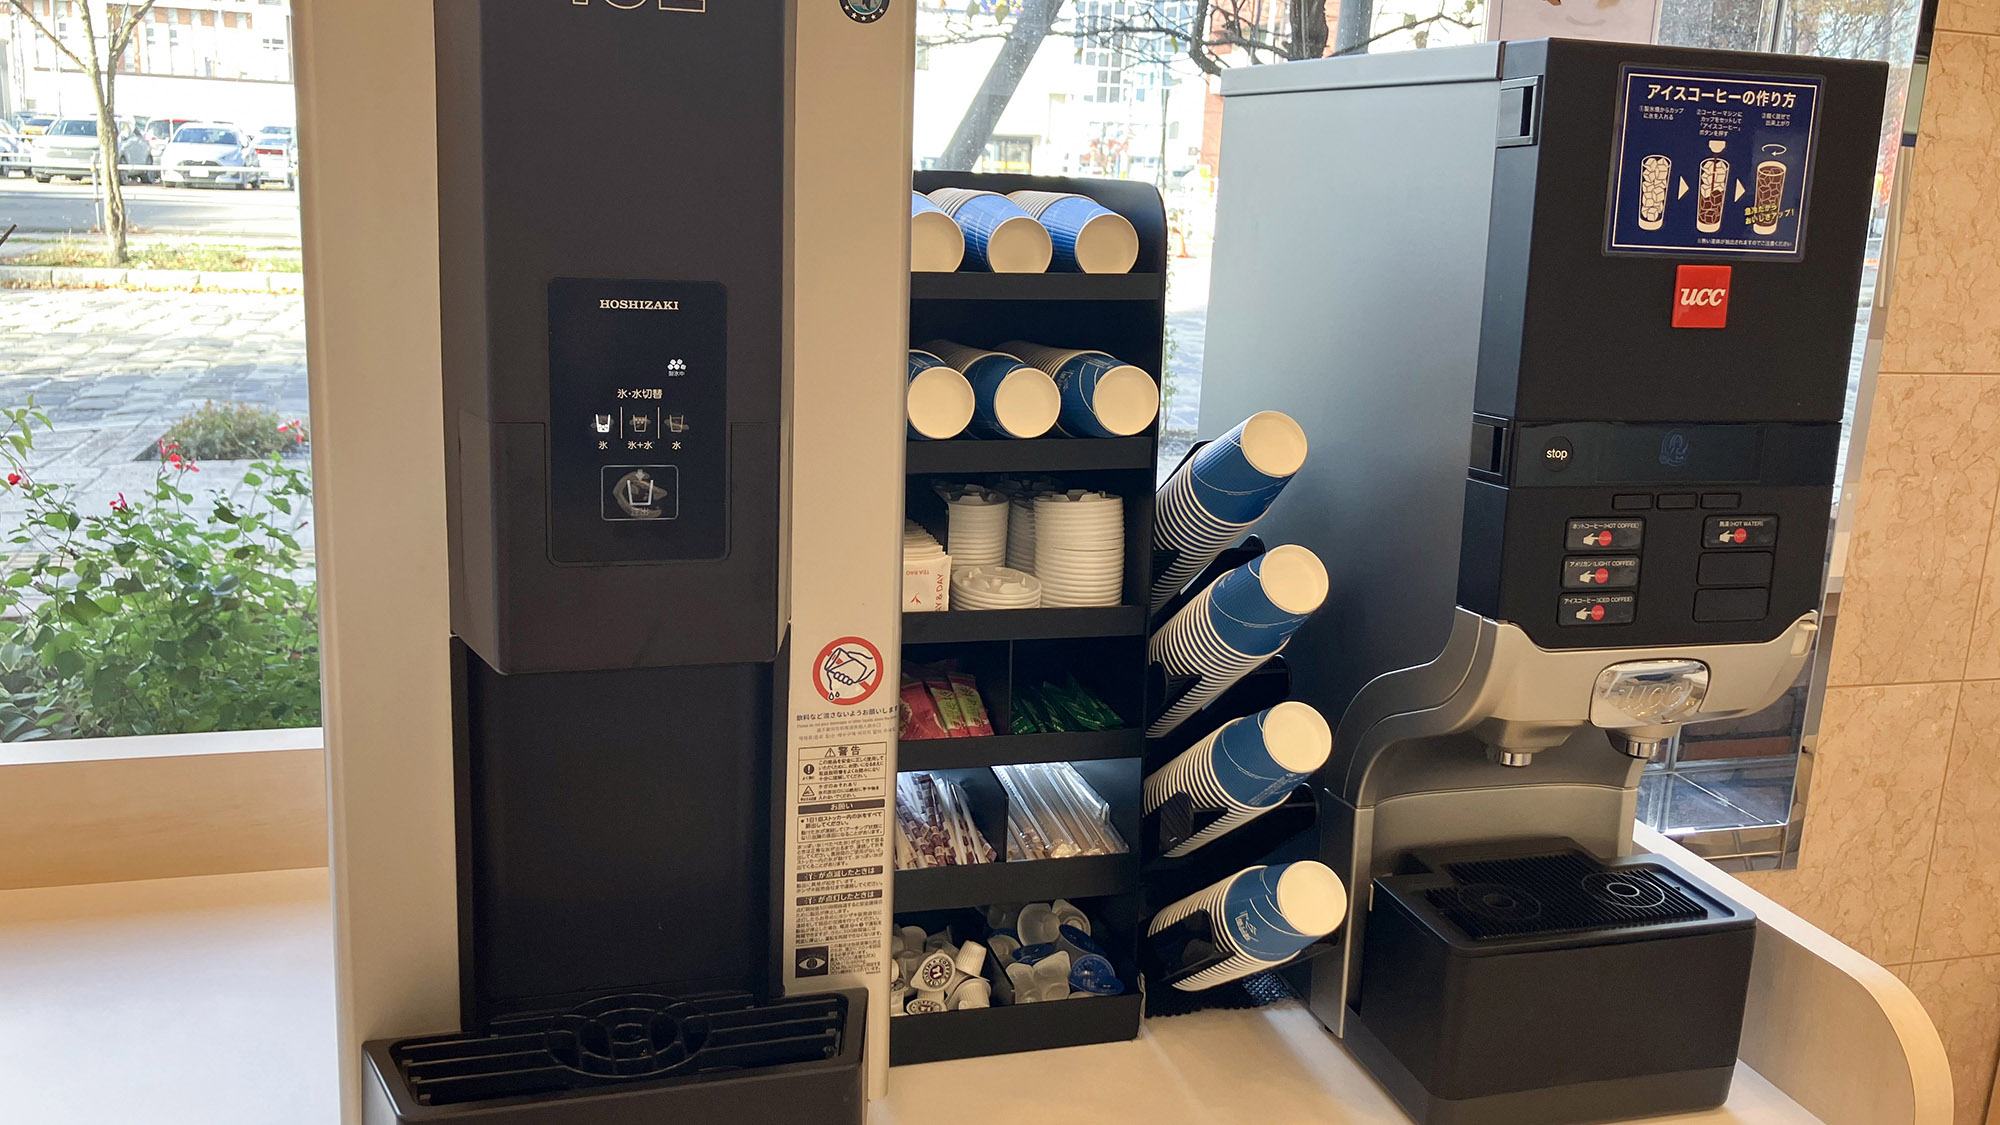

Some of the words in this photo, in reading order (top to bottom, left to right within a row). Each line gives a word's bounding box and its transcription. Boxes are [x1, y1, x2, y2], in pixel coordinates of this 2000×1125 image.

[1647, 84, 1797, 109] アイスコーヒーの作り方
[1643, 113, 1674, 121] に氷を入れる
[1700, 116, 1742, 124] カップをセットして
[599, 299, 680, 311] HOSHIZAKI
[598, 441, 608, 450] 氷
[671, 441, 681, 450] 水
[1546, 448, 1568, 461] stop
[935, 573, 943, 592] DAY
[838, 745, 861, 756] 警告
[830, 801, 854, 811] お願い
